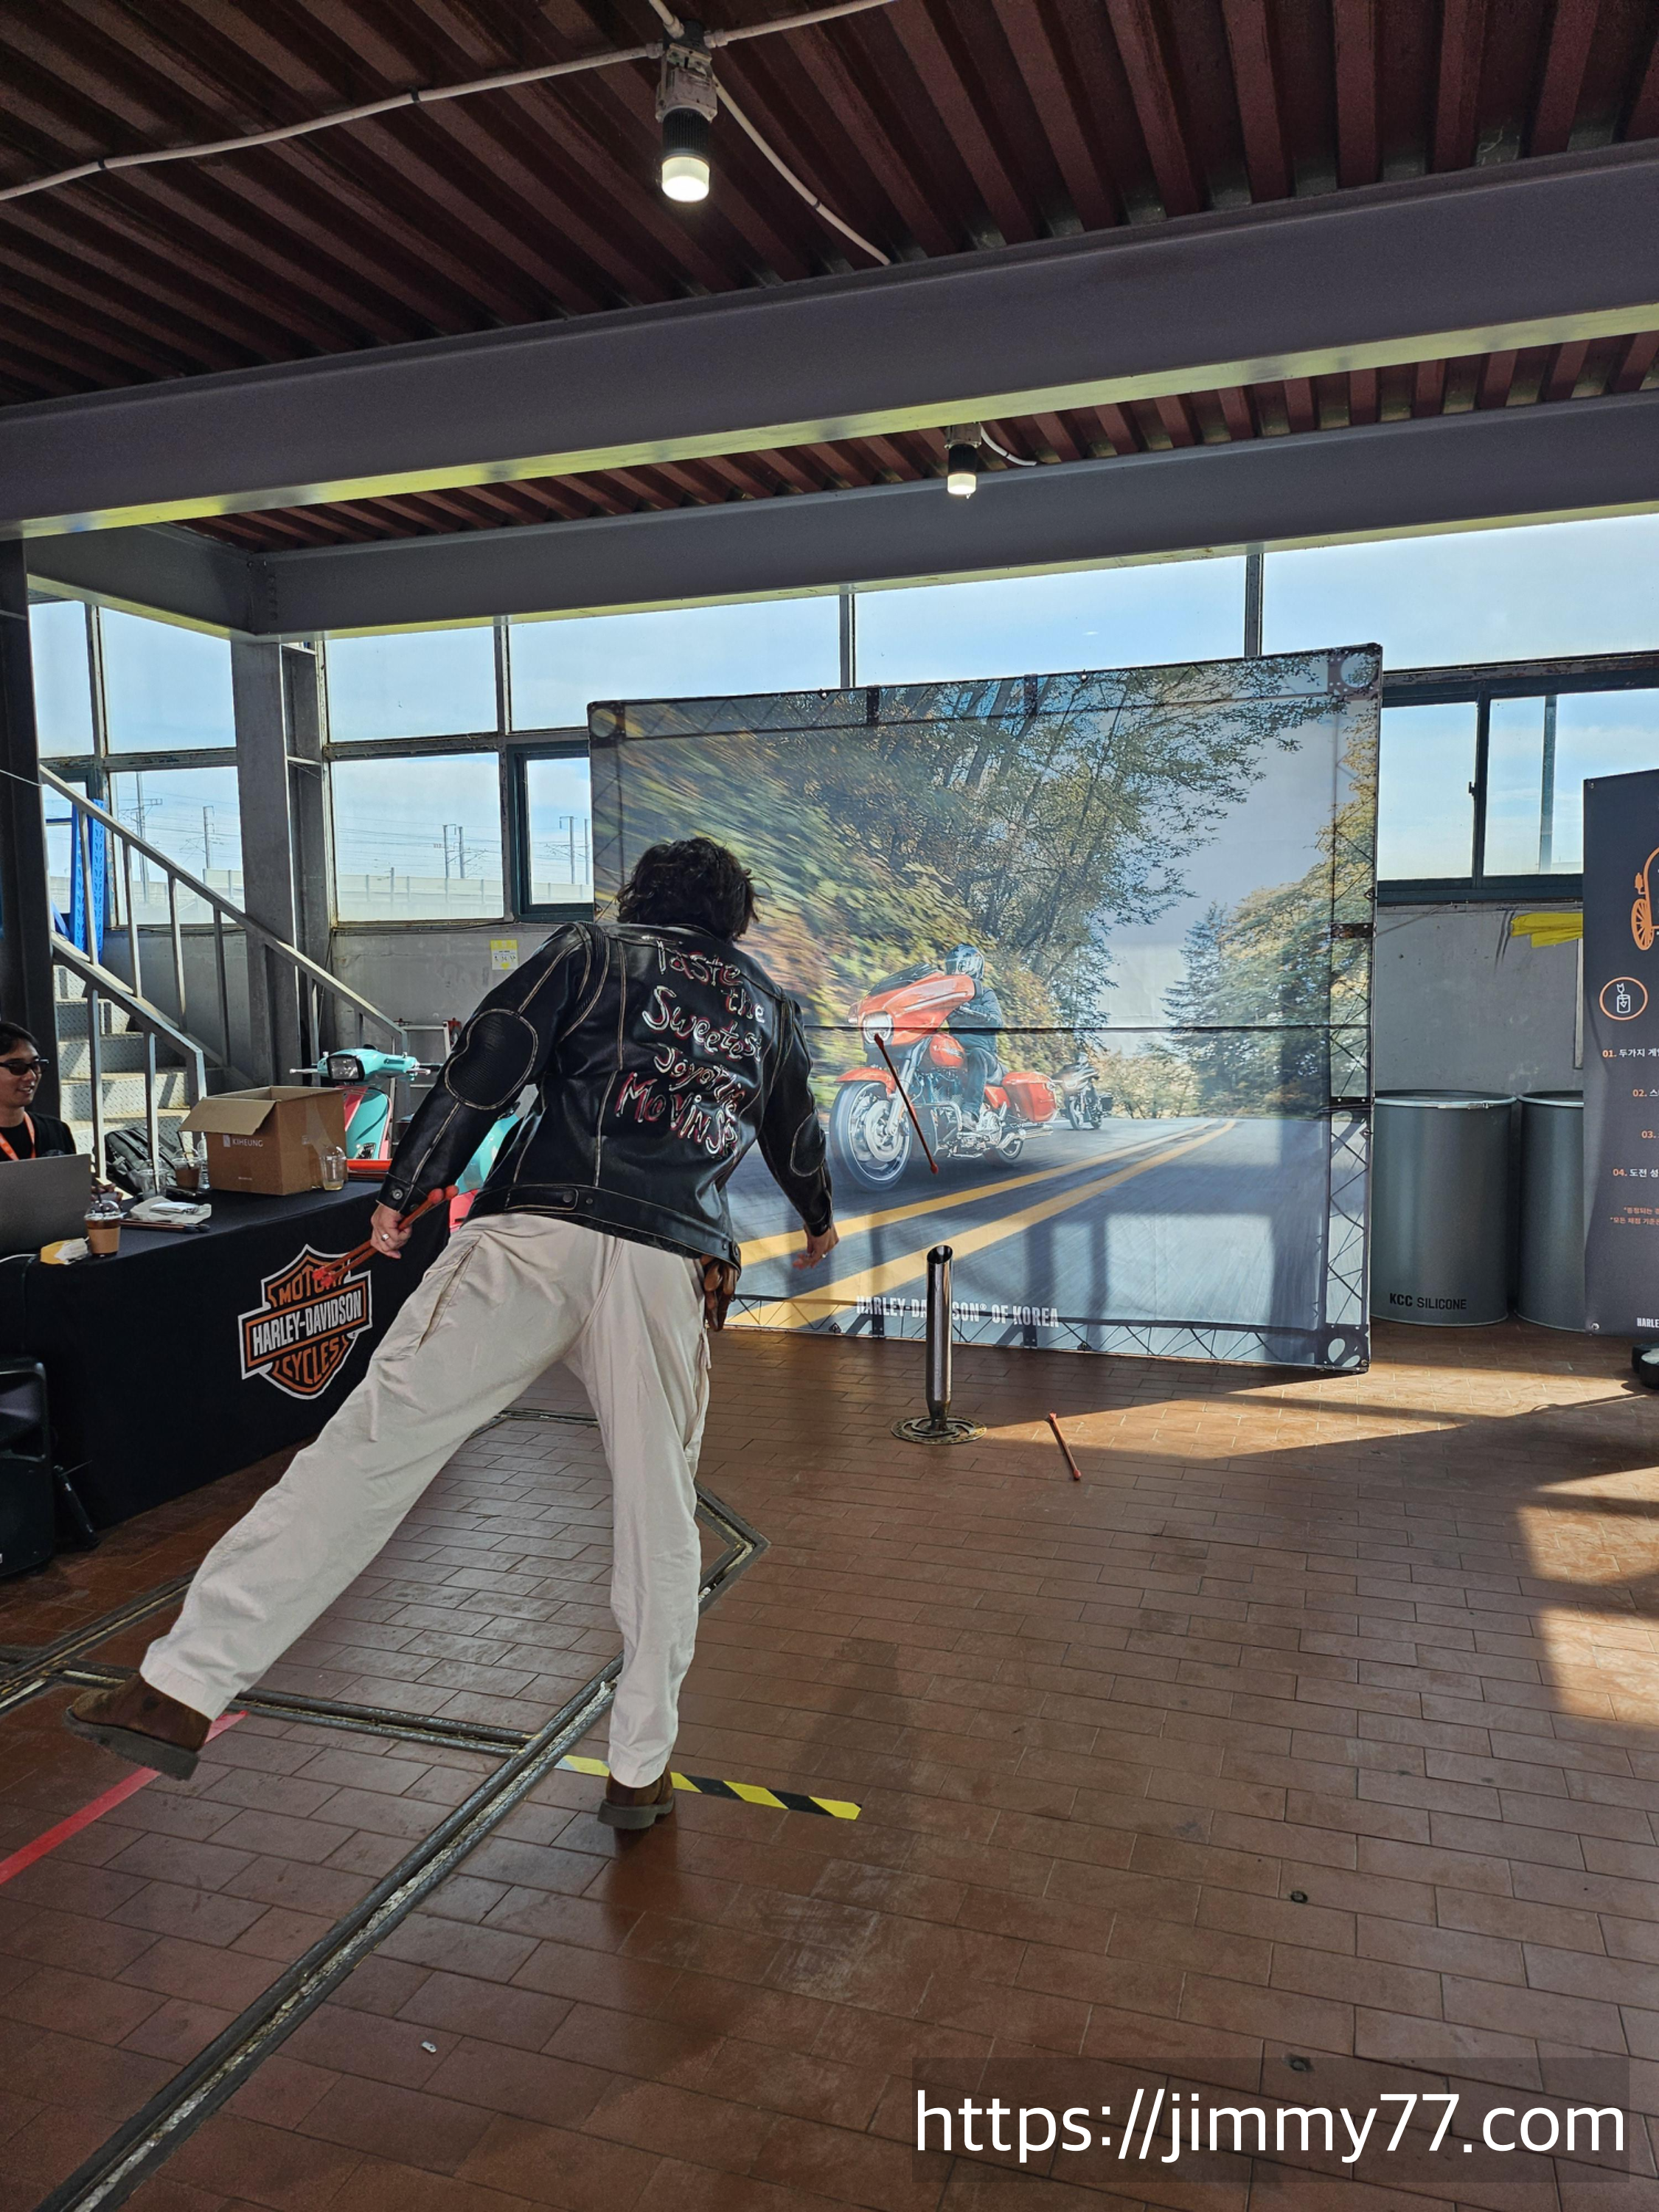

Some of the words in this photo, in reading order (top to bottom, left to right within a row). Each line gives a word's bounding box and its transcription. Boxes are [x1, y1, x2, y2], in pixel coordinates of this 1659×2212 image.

[720, 987, 765, 1023] the
[1602, 1049, 1617, 1058] 01.
[1619, 1048, 1646, 1058] 두가지
[1632, 1088, 1647, 1097] 02.
[1641, 1130, 1657, 1139] 03.
[1613, 1168, 1627, 1177] 04.
[1630, 1168, 1647, 1178] 도전
[1389, 1293, 1413, 1307] KCC
[1416, 1296, 1467, 1310] SILICONE
[253, 1290, 363, 1357] HARLEY-DAVIDSON
[991, 1304, 1009, 1324] OF
[1012, 1305, 1060, 1327] KOREA
[282, 1337, 340, 1384] CYCLES
